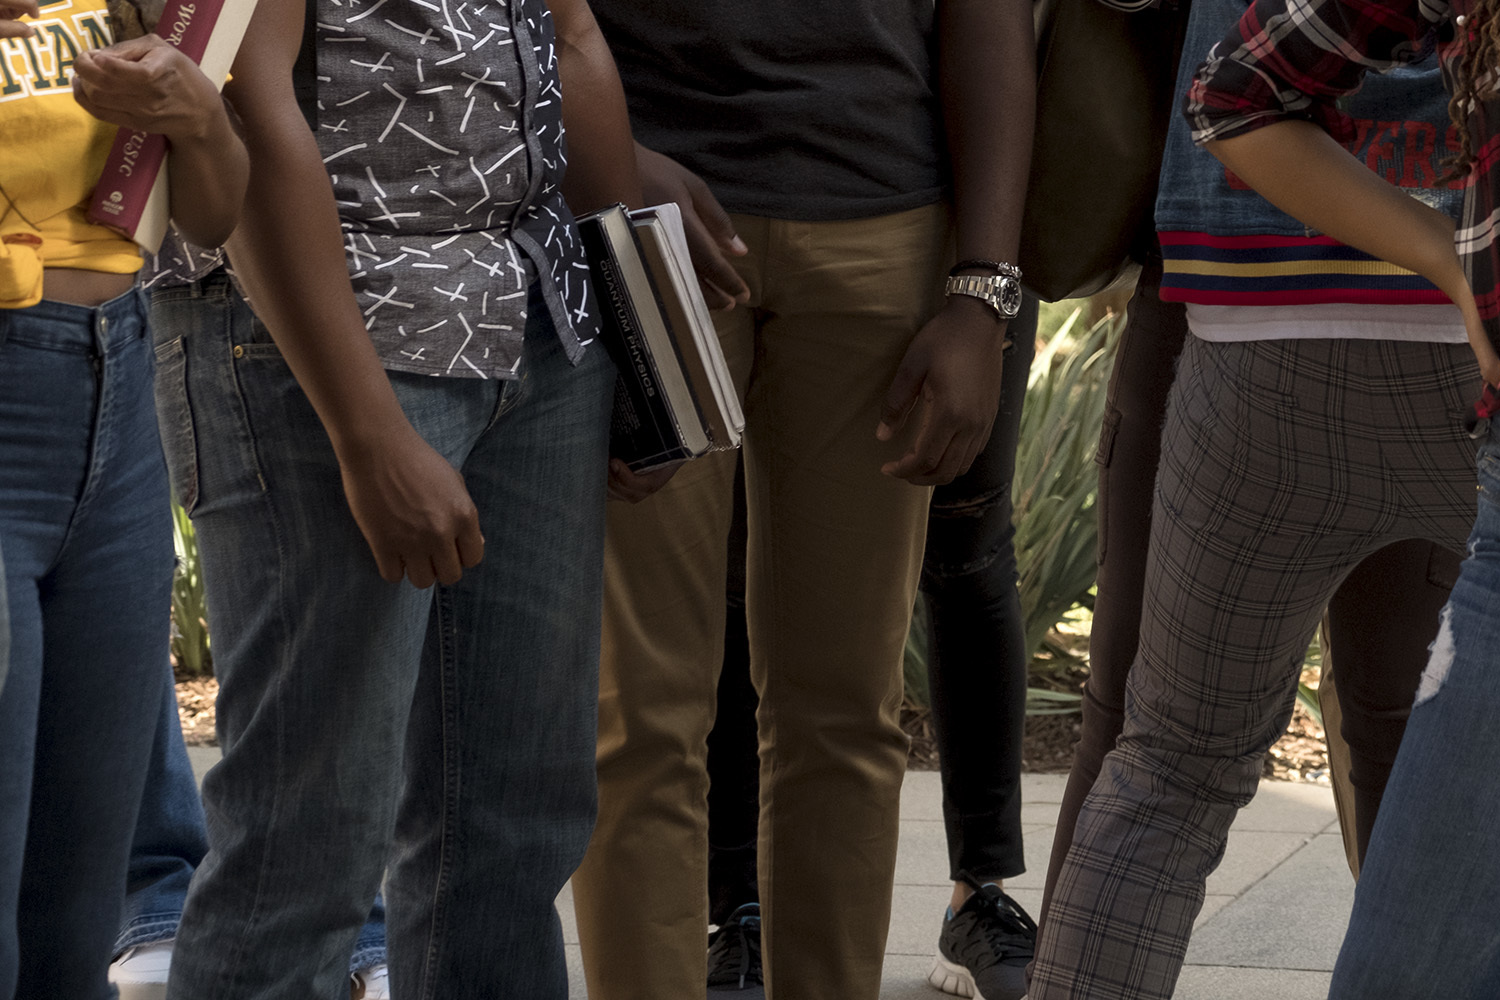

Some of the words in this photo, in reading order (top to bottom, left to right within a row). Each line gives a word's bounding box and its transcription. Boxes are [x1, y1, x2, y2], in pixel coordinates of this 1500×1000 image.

[166, 3, 196, 47] WOR
[600, 260, 630, 333] QUANTUM
[627, 335, 655, 397] PHYSICS
